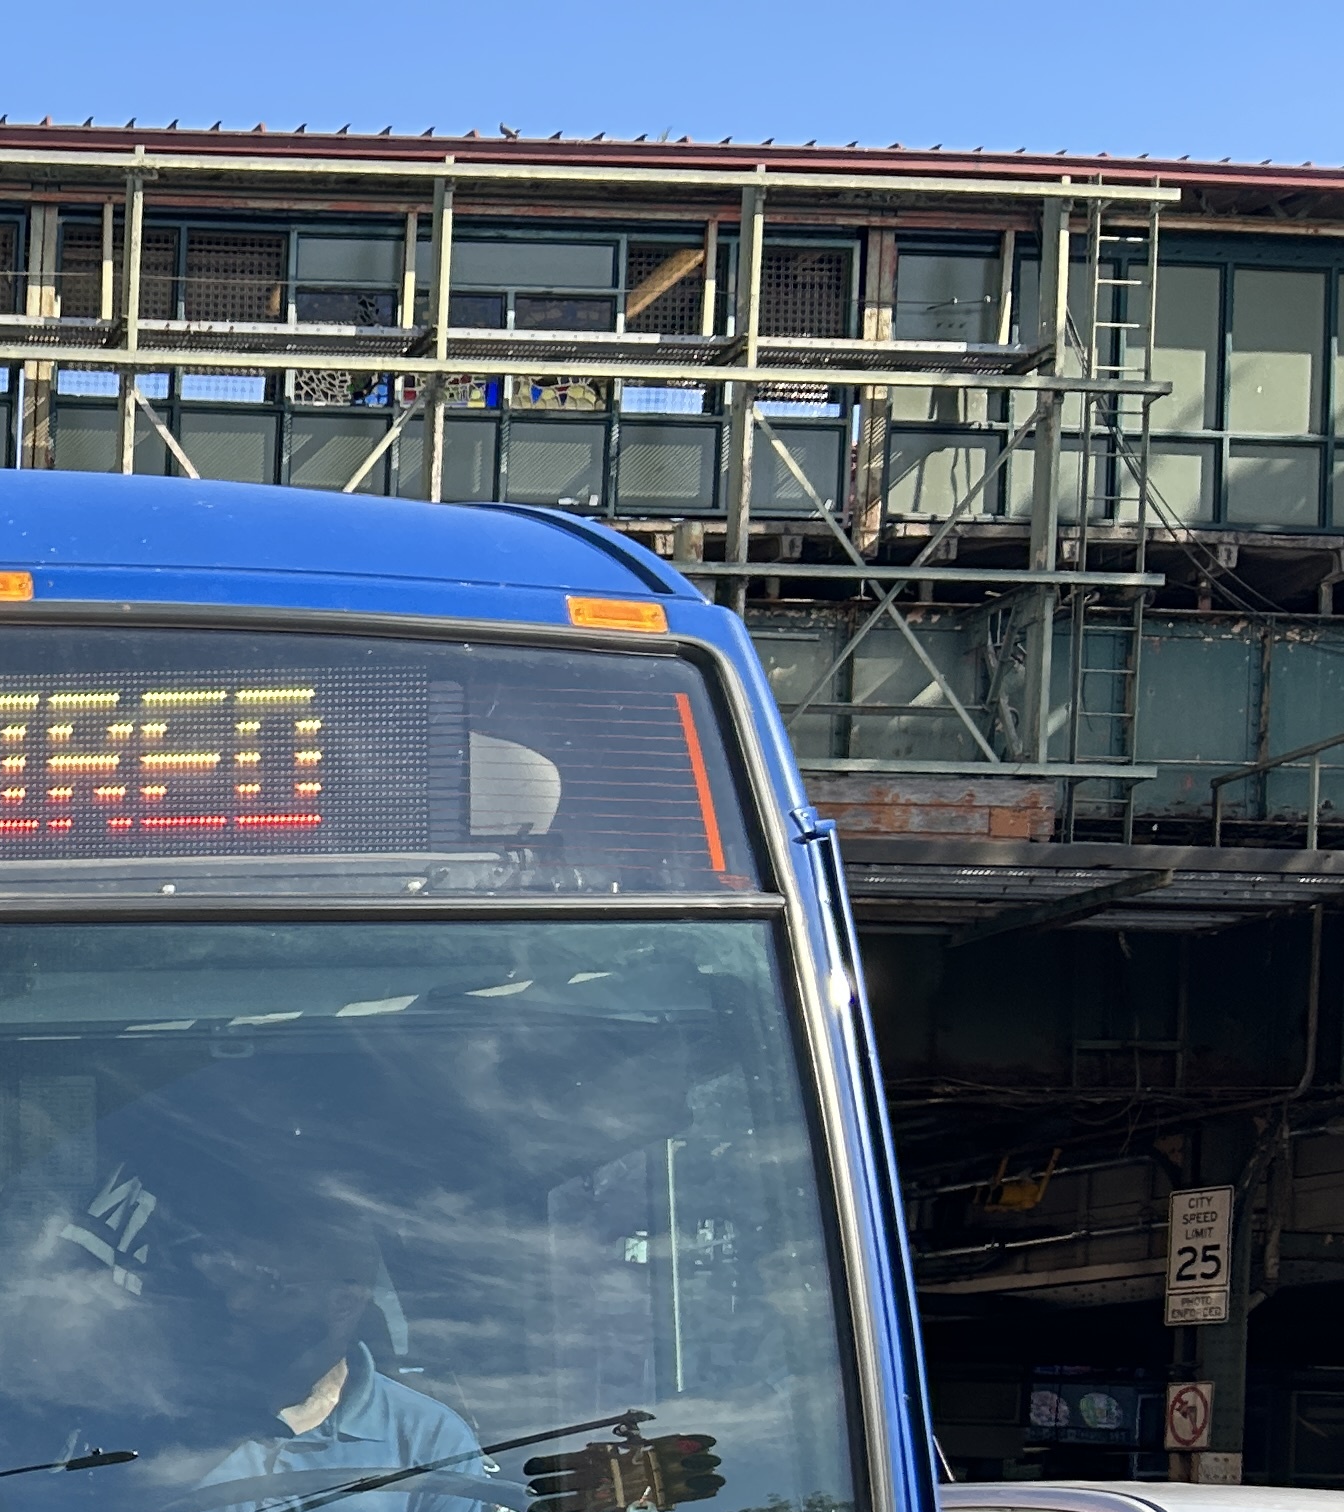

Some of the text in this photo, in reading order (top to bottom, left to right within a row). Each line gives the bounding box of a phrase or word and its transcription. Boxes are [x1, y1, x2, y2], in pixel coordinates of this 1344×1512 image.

[1188, 1196, 1214, 1209] CITY
[1182, 1211, 1218, 1225] SPEED
[1185, 1227, 1214, 1240] LIMIT
[1176, 1244, 1221, 1281] 25
